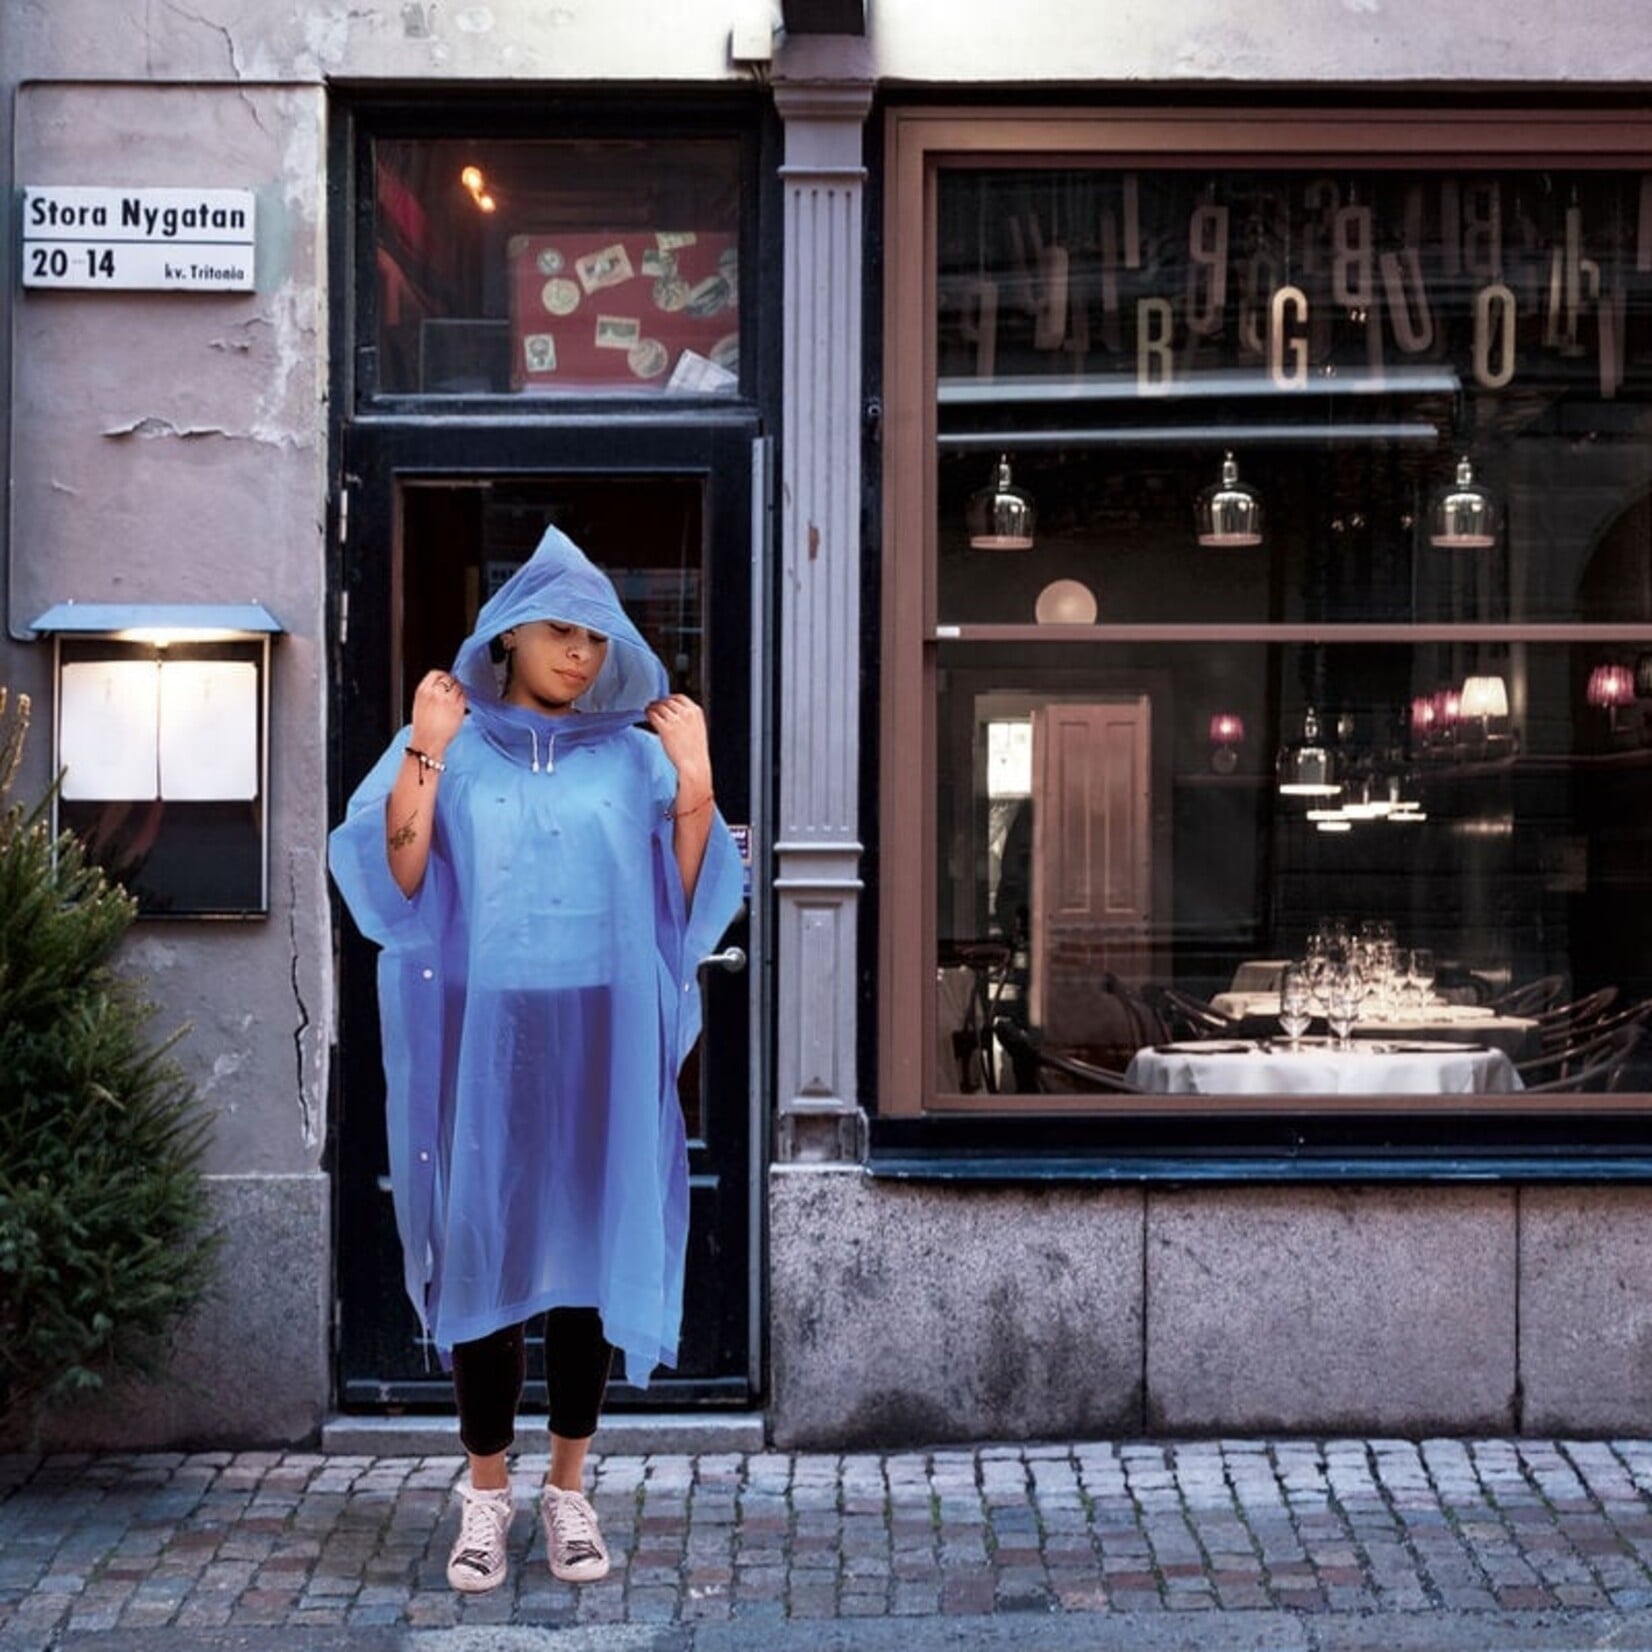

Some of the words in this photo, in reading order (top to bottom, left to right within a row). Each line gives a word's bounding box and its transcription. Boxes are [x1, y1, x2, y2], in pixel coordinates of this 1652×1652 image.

[31, 197, 107, 227] Stora
[121, 198, 245, 237] Nygatan
[190, 264, 245, 280] Tritonia
